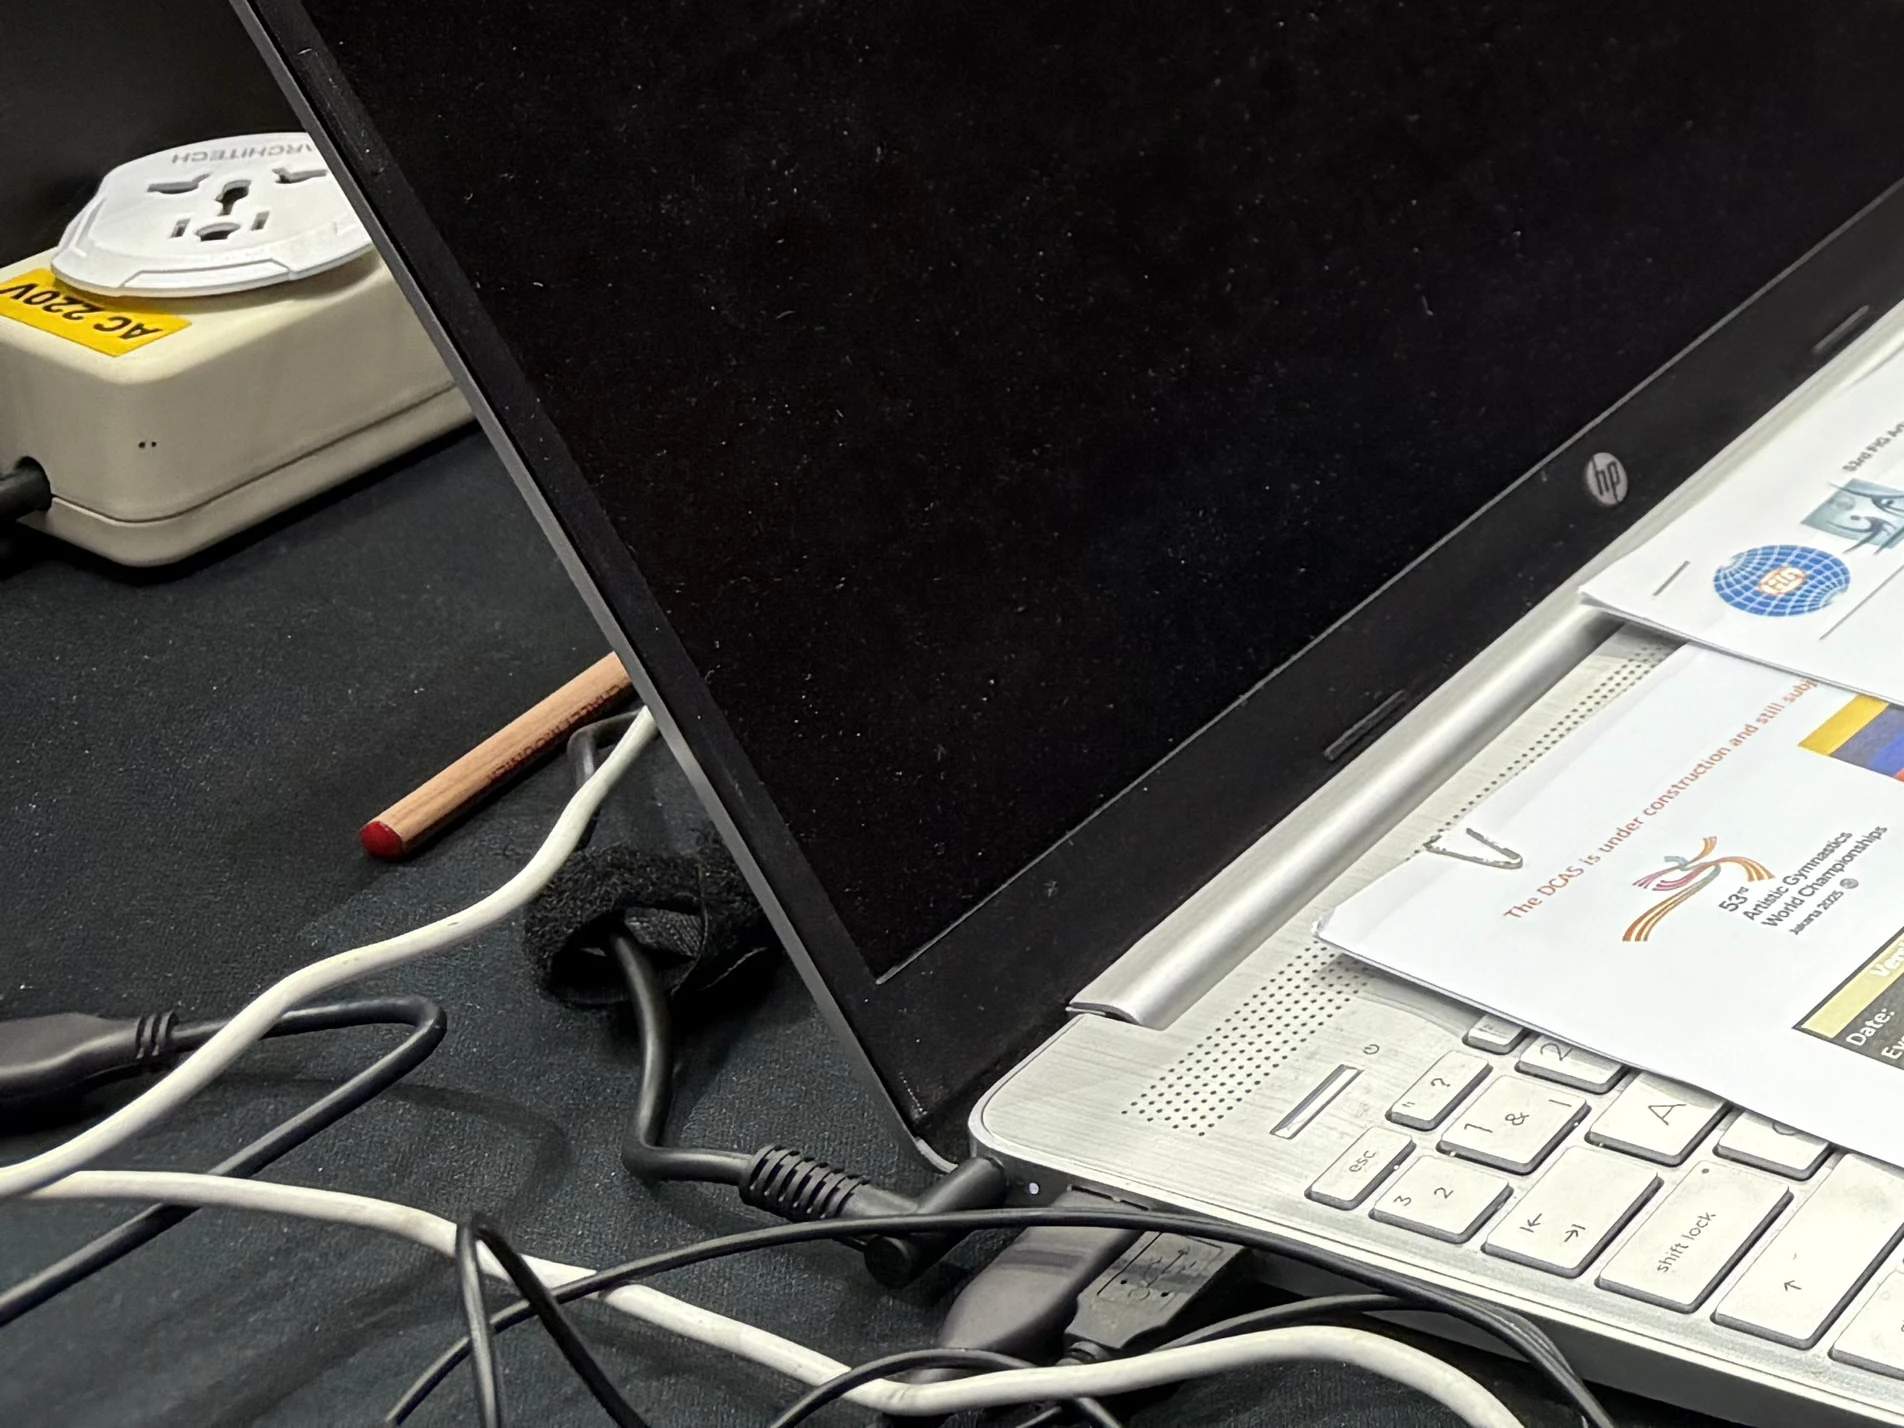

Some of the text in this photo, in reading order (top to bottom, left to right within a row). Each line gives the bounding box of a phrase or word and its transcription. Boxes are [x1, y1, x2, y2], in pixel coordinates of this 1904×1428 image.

[0, 282, 163, 341] AC 220V
[1504, 896, 1542, 918] The
[1537, 866, 1584, 896] DCAS
[1579, 852, 1600, 865] is
[1599, 817, 1643, 852] under
[1643, 748, 1731, 816] construction
[1728, 724, 1759, 746] and
[1754, 703, 1785, 724] still
[1743, 832, 1852, 920] Artistic Gymnastics
[1761, 827, 1887, 926] World Championships
[1789, 890, 1844, 935] Jakarta 2025
[1846, 1009, 1894, 1045] Date:
[1646, 1102, 1687, 1126] A
[1348, 1149, 1377, 1174] esc
[1655, 1211, 1717, 1274] shift lock
